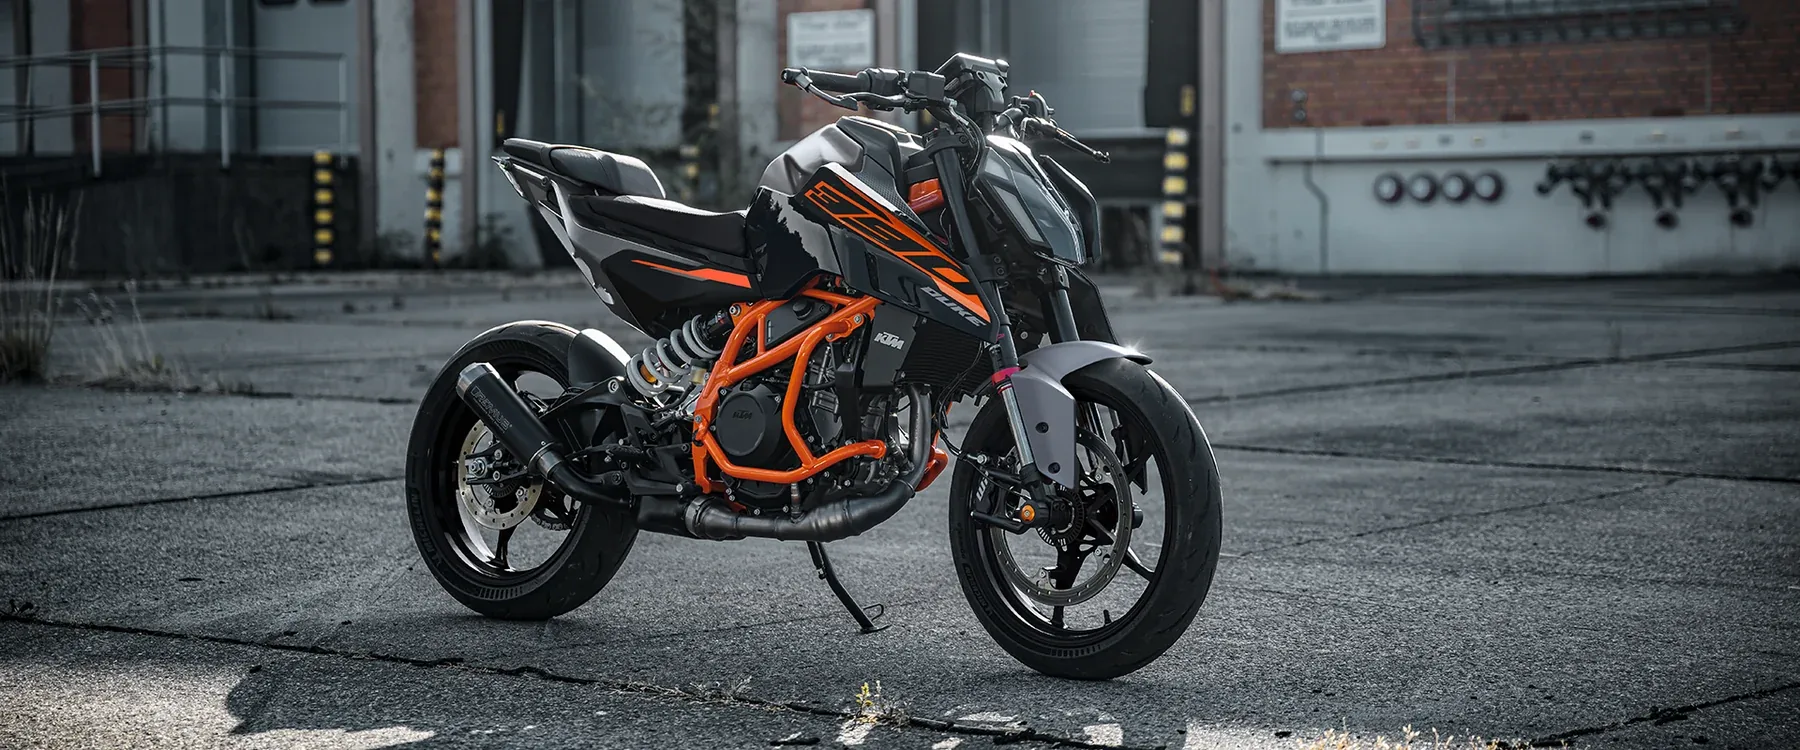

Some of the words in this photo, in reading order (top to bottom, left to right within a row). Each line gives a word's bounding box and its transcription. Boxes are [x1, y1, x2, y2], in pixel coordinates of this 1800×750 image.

[804, 181, 980, 295] 390
[920, 286, 986, 327] DUKE
[874, 331, 905, 350] KTM
[732, 410, 752, 420] KTM
[411, 492, 434, 552] MICHELIN
